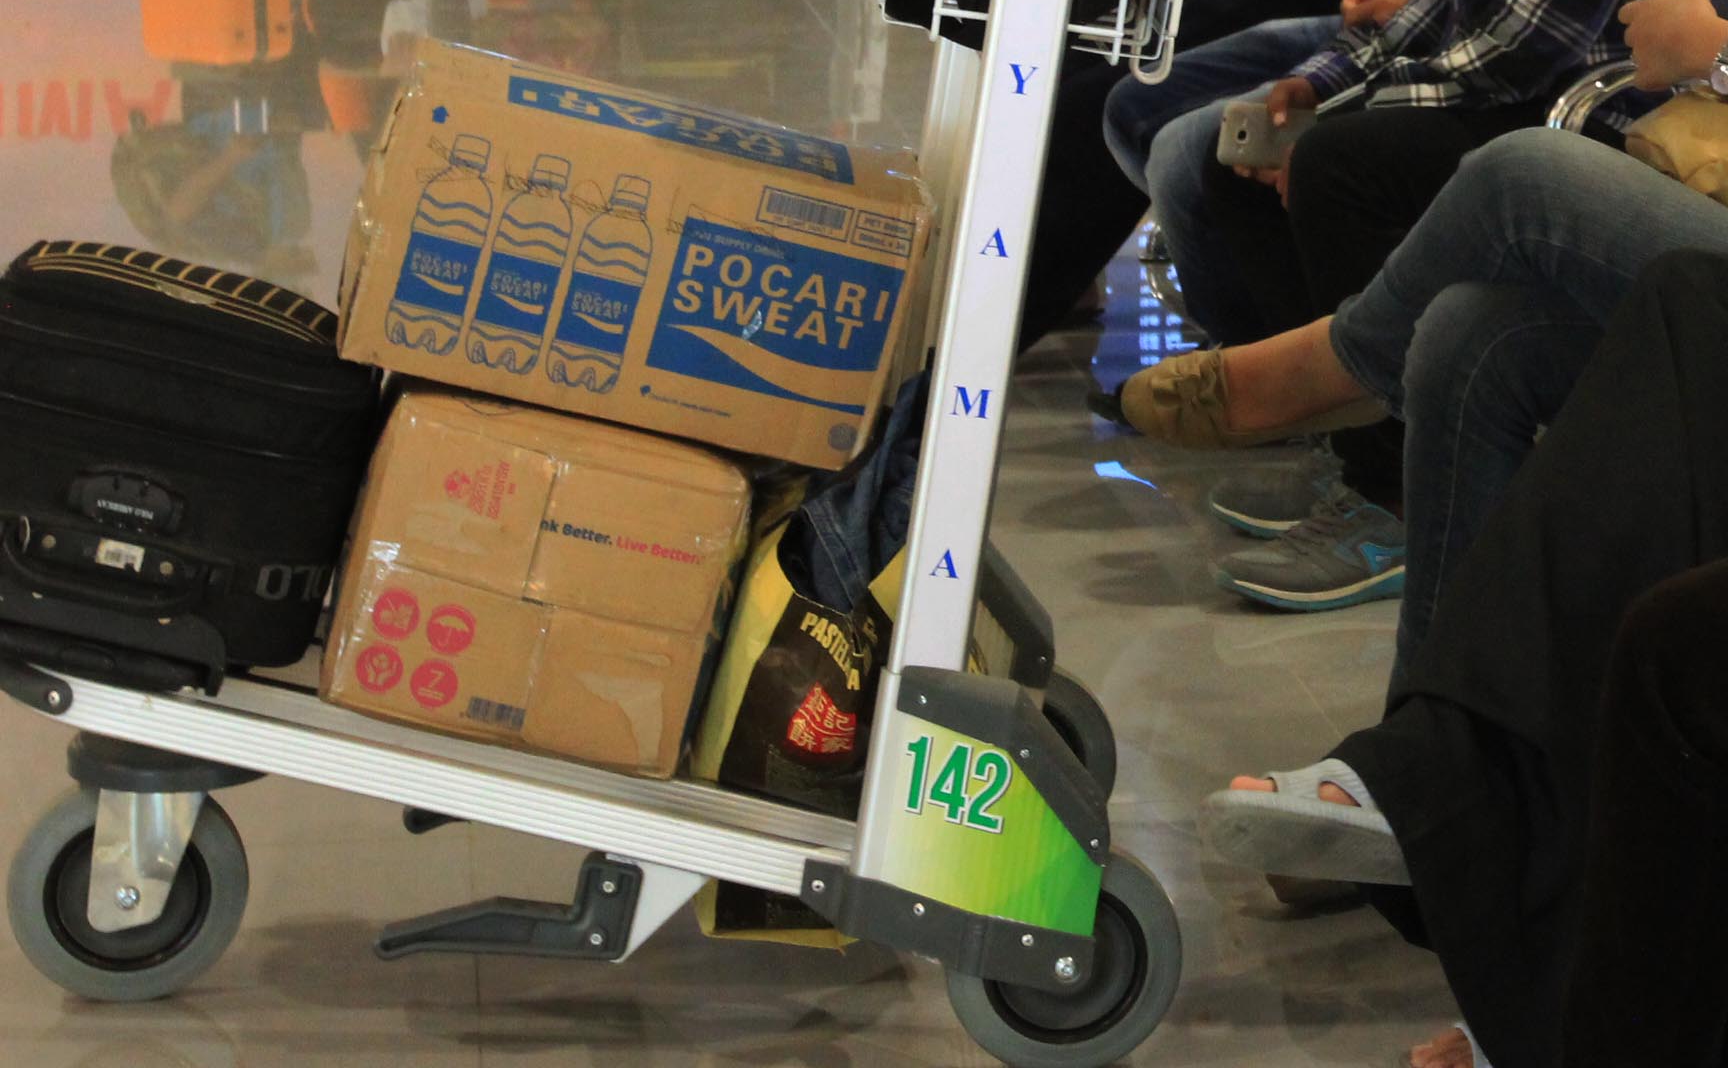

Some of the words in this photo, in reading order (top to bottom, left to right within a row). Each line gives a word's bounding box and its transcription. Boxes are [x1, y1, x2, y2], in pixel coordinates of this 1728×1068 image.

[411, 260, 460, 280] SWEAT
[413, 250, 467, 273] POCARI
[490, 281, 540, 301] SWEAT
[493, 271, 547, 294] POCARI
[682, 243, 890, 322] POCARI
[571, 300, 620, 320] SWEAT
[574, 291, 628, 313] POCARI
[673, 279, 864, 350] SWEAT
[616, 535, 648, 554] Live
[800, 611, 860, 690] PASTELA
[906, 735, 1010, 832] 142
